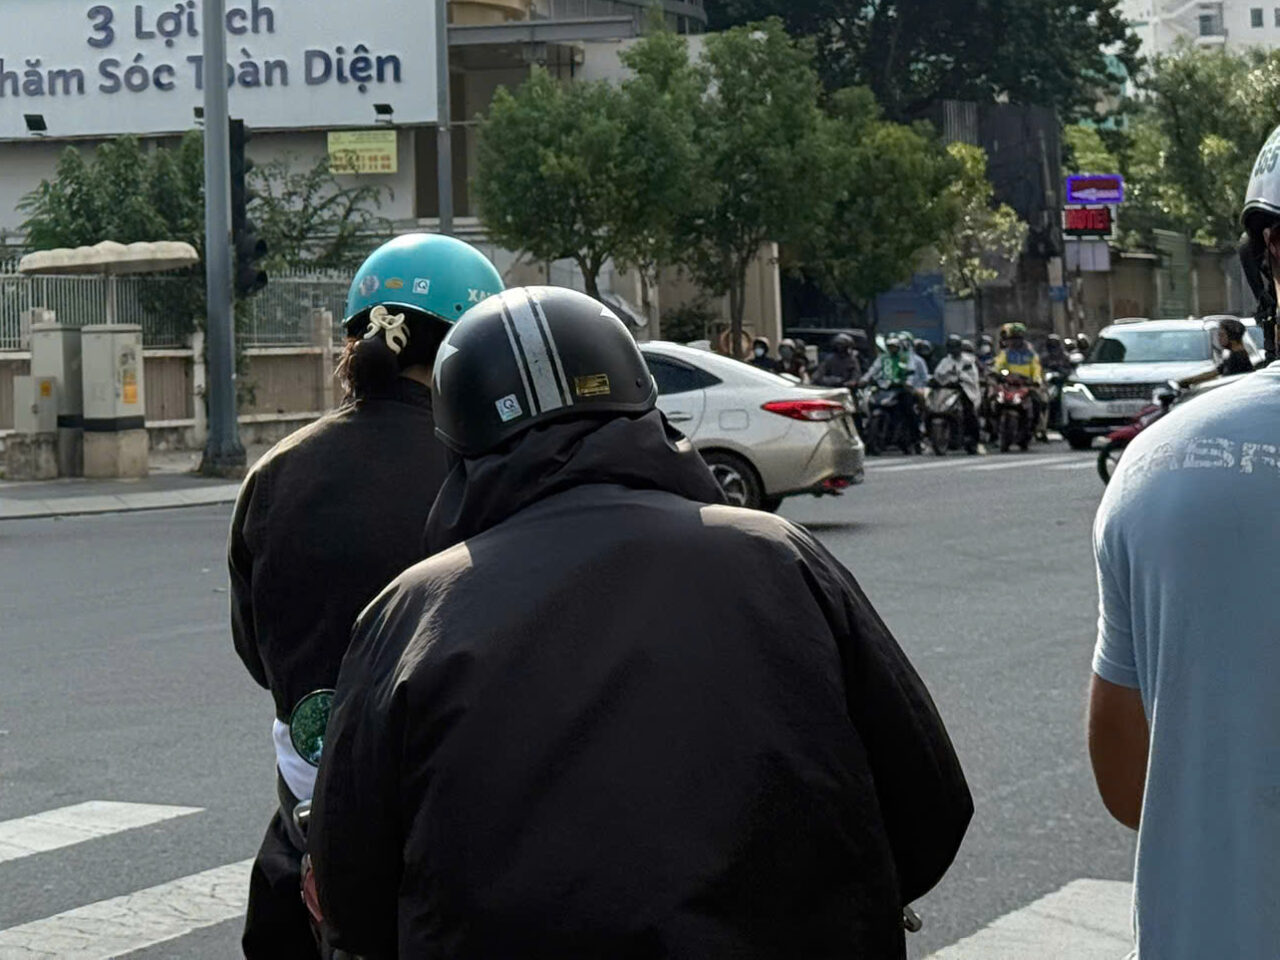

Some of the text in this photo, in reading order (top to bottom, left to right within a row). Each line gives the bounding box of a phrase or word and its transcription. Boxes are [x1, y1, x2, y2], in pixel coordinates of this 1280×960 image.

[86, 5, 116, 48] 3
[134, 0, 199, 48] Lợi
[98, 53, 175, 94] Sóc
[304, 43, 402, 94] Diện
